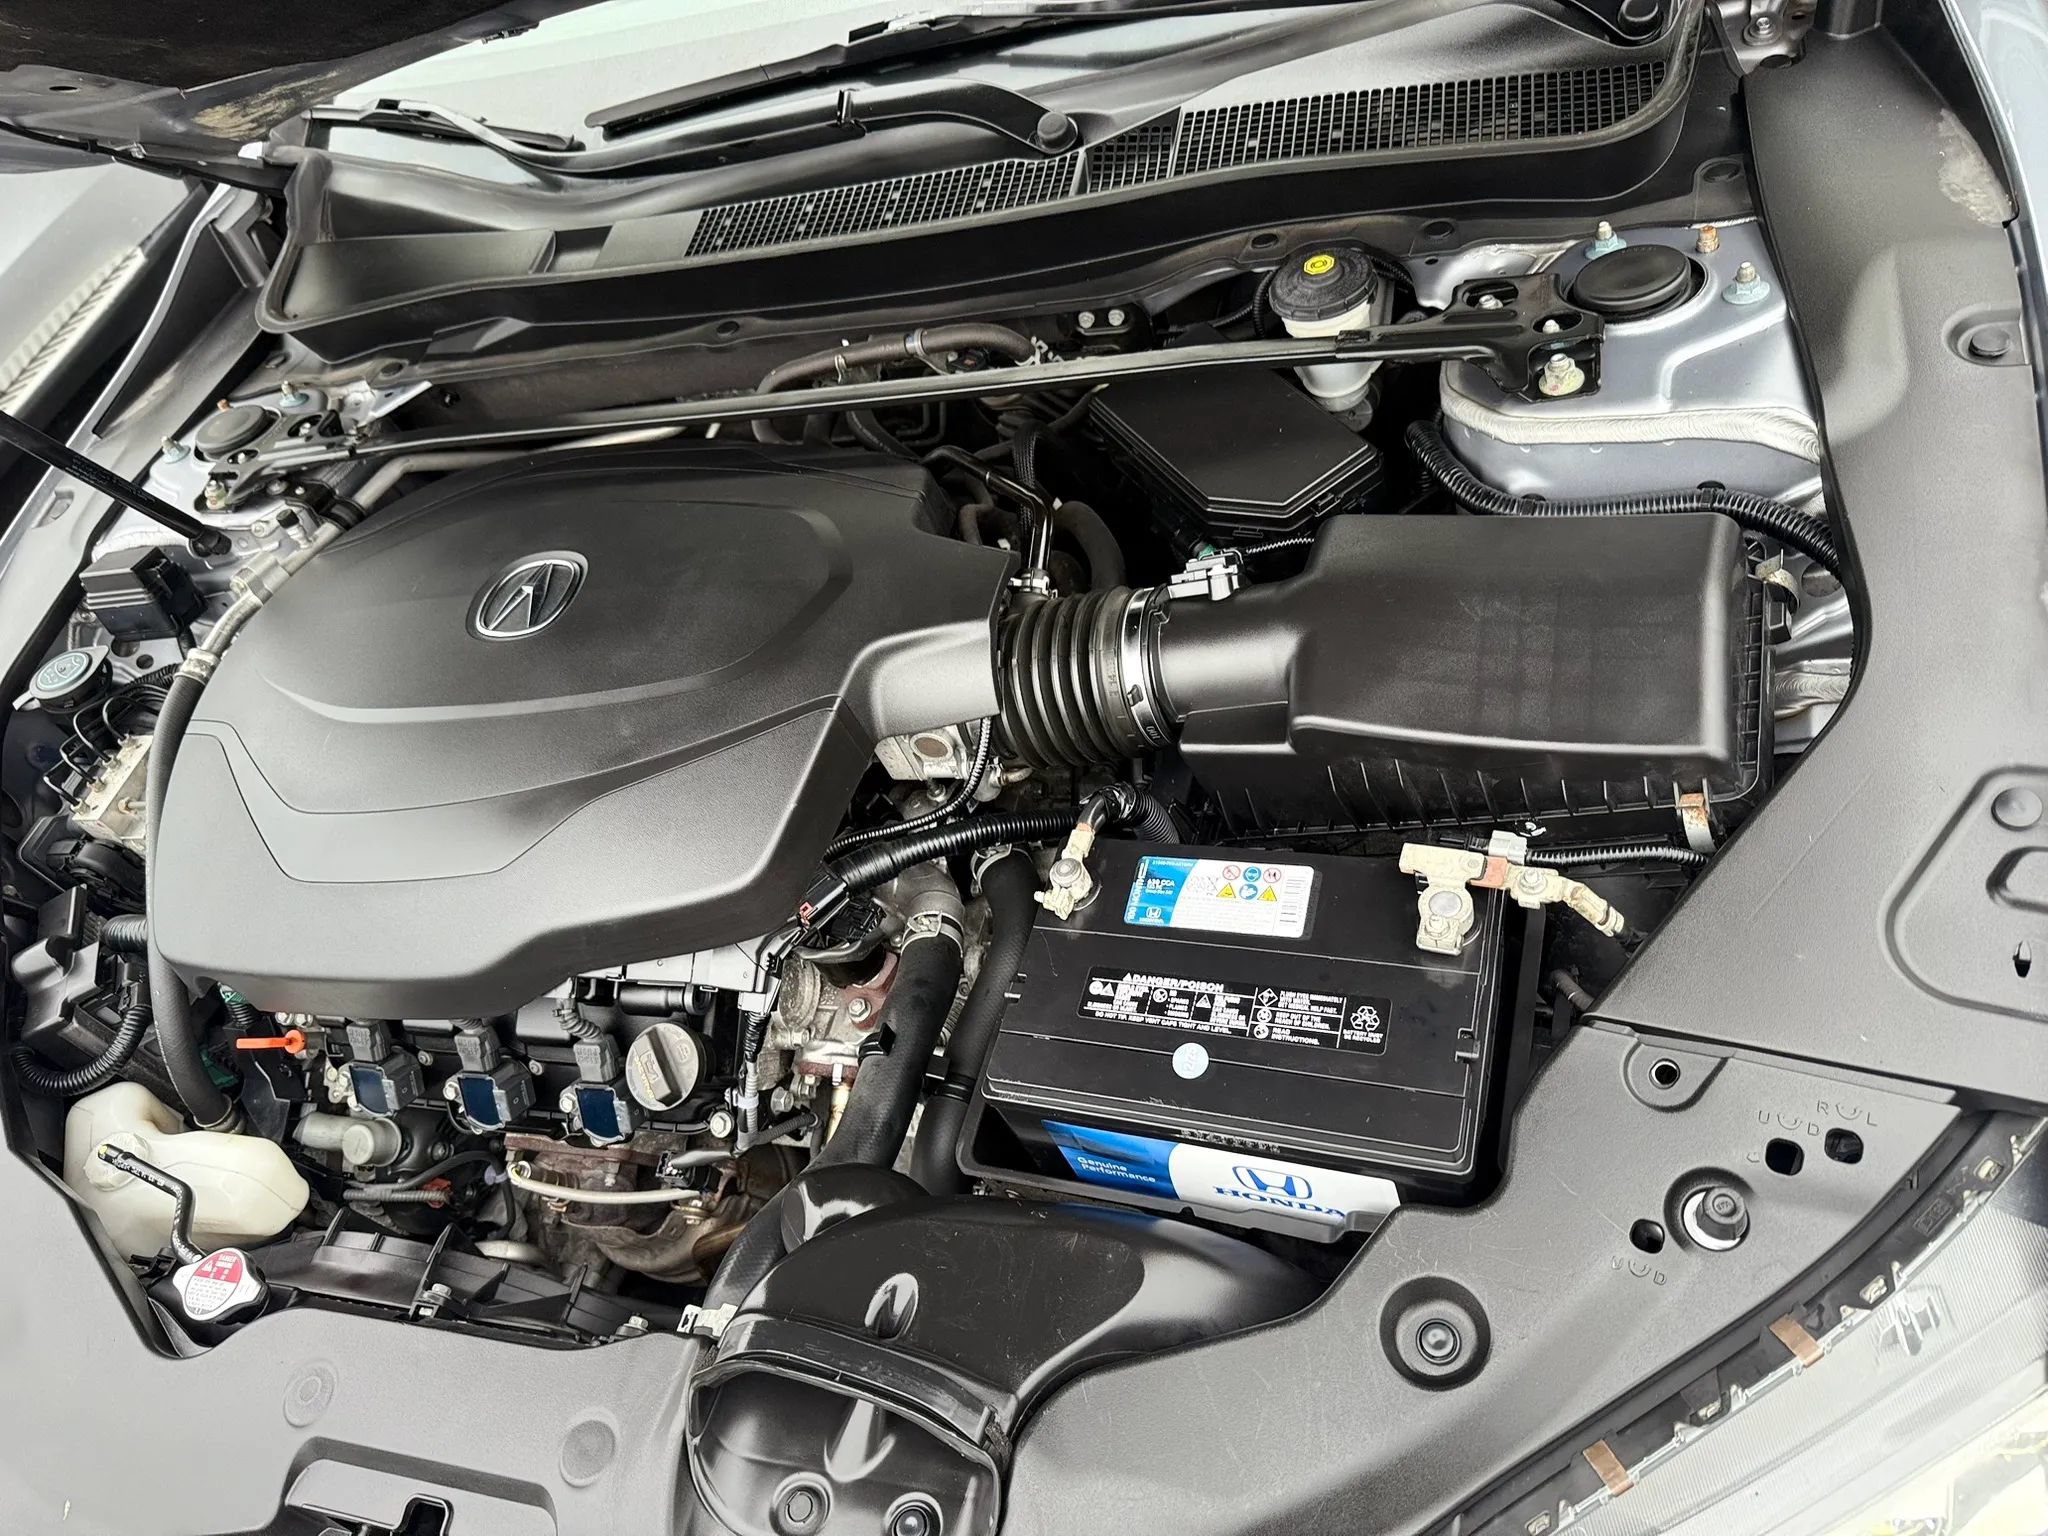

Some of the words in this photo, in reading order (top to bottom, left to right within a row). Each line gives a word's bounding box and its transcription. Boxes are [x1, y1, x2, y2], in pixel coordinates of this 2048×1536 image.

[1077, 1156, 1129, 1173] Genuine
[1081, 1163, 1157, 1183] Performance
[1213, 1186, 1346, 1217] HONDA
